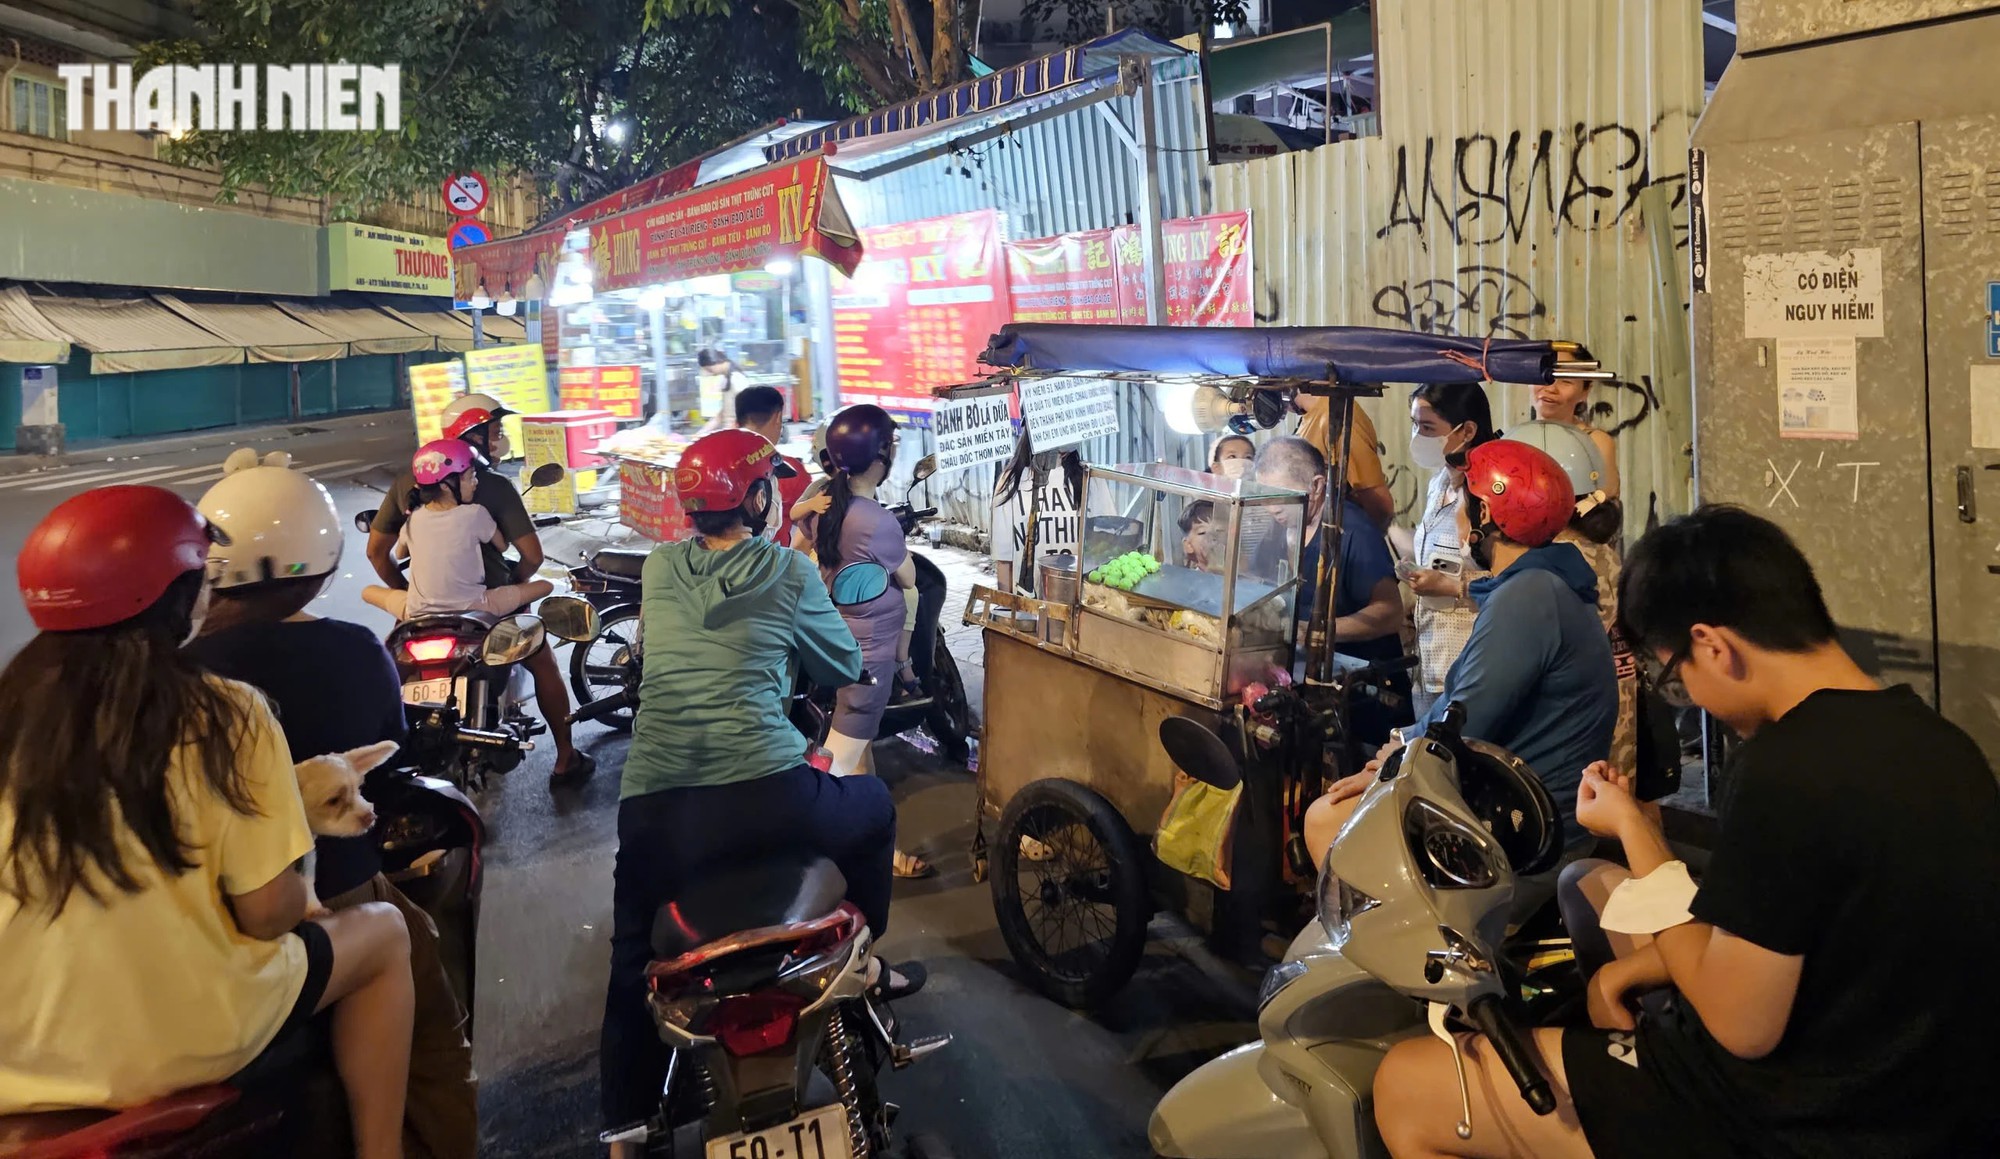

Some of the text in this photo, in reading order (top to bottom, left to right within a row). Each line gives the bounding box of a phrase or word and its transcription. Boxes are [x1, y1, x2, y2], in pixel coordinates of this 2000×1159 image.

[613, 218, 641, 276] HÙNG
[1164, 234, 1187, 264] NG
[394, 248, 449, 280] THƯƠNG
[1797, 267, 1858, 294] CÓ ĐIỆN
[1786, 294, 1874, 321] NGUY HIỂM!
[936, 402, 963, 436] BÁNH
[979, 404, 991, 426] LÁ
[1013, 516, 1080, 551] NTHI
[413, 682, 453, 702] 60-B
